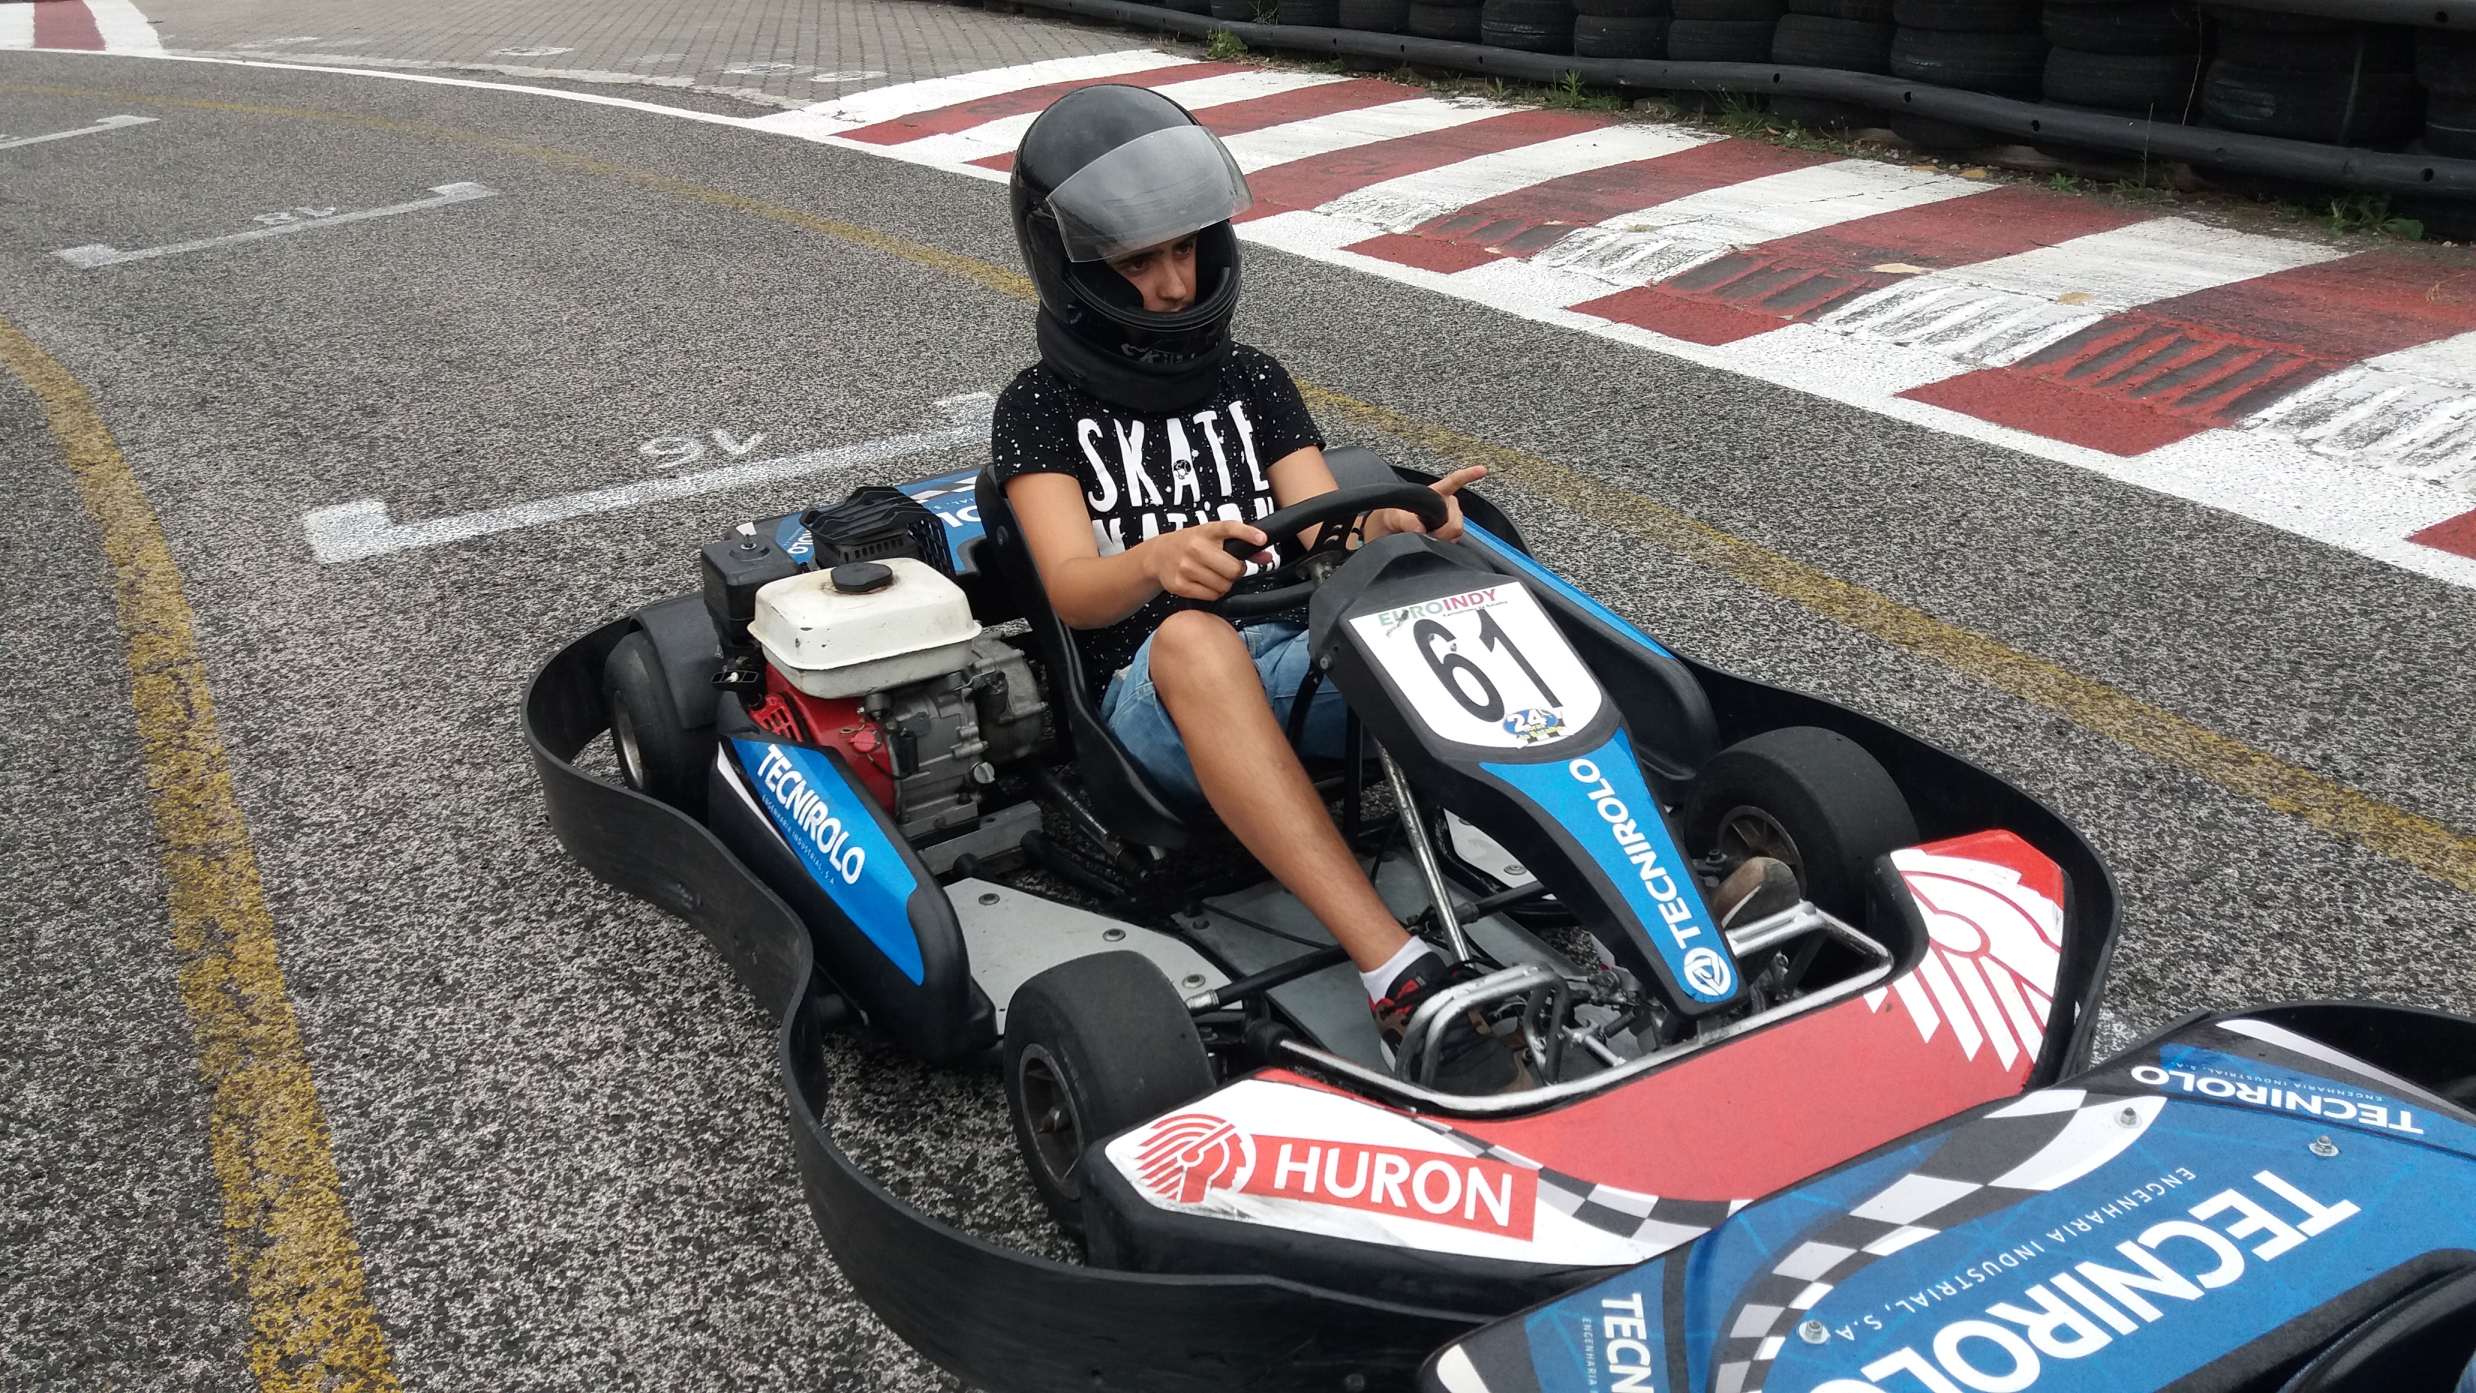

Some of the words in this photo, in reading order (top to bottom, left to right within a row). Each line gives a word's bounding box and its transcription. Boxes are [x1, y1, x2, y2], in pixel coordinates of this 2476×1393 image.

[1077, 400, 1269, 513] SKATE
[1379, 588, 1498, 627] EUROINDY
[1413, 608, 1565, 723] 61
[757, 744, 865, 885] TECNIROLO
[1568, 758, 1702, 950] TECNIROLO
[2131, 1065, 2425, 1135] TECNIROLO
[1273, 1142, 1513, 1228] HURON
[2045, 1167, 2197, 1244] ENGENHARIA
[1808, 1169, 2361, 1393] TECNIROL
